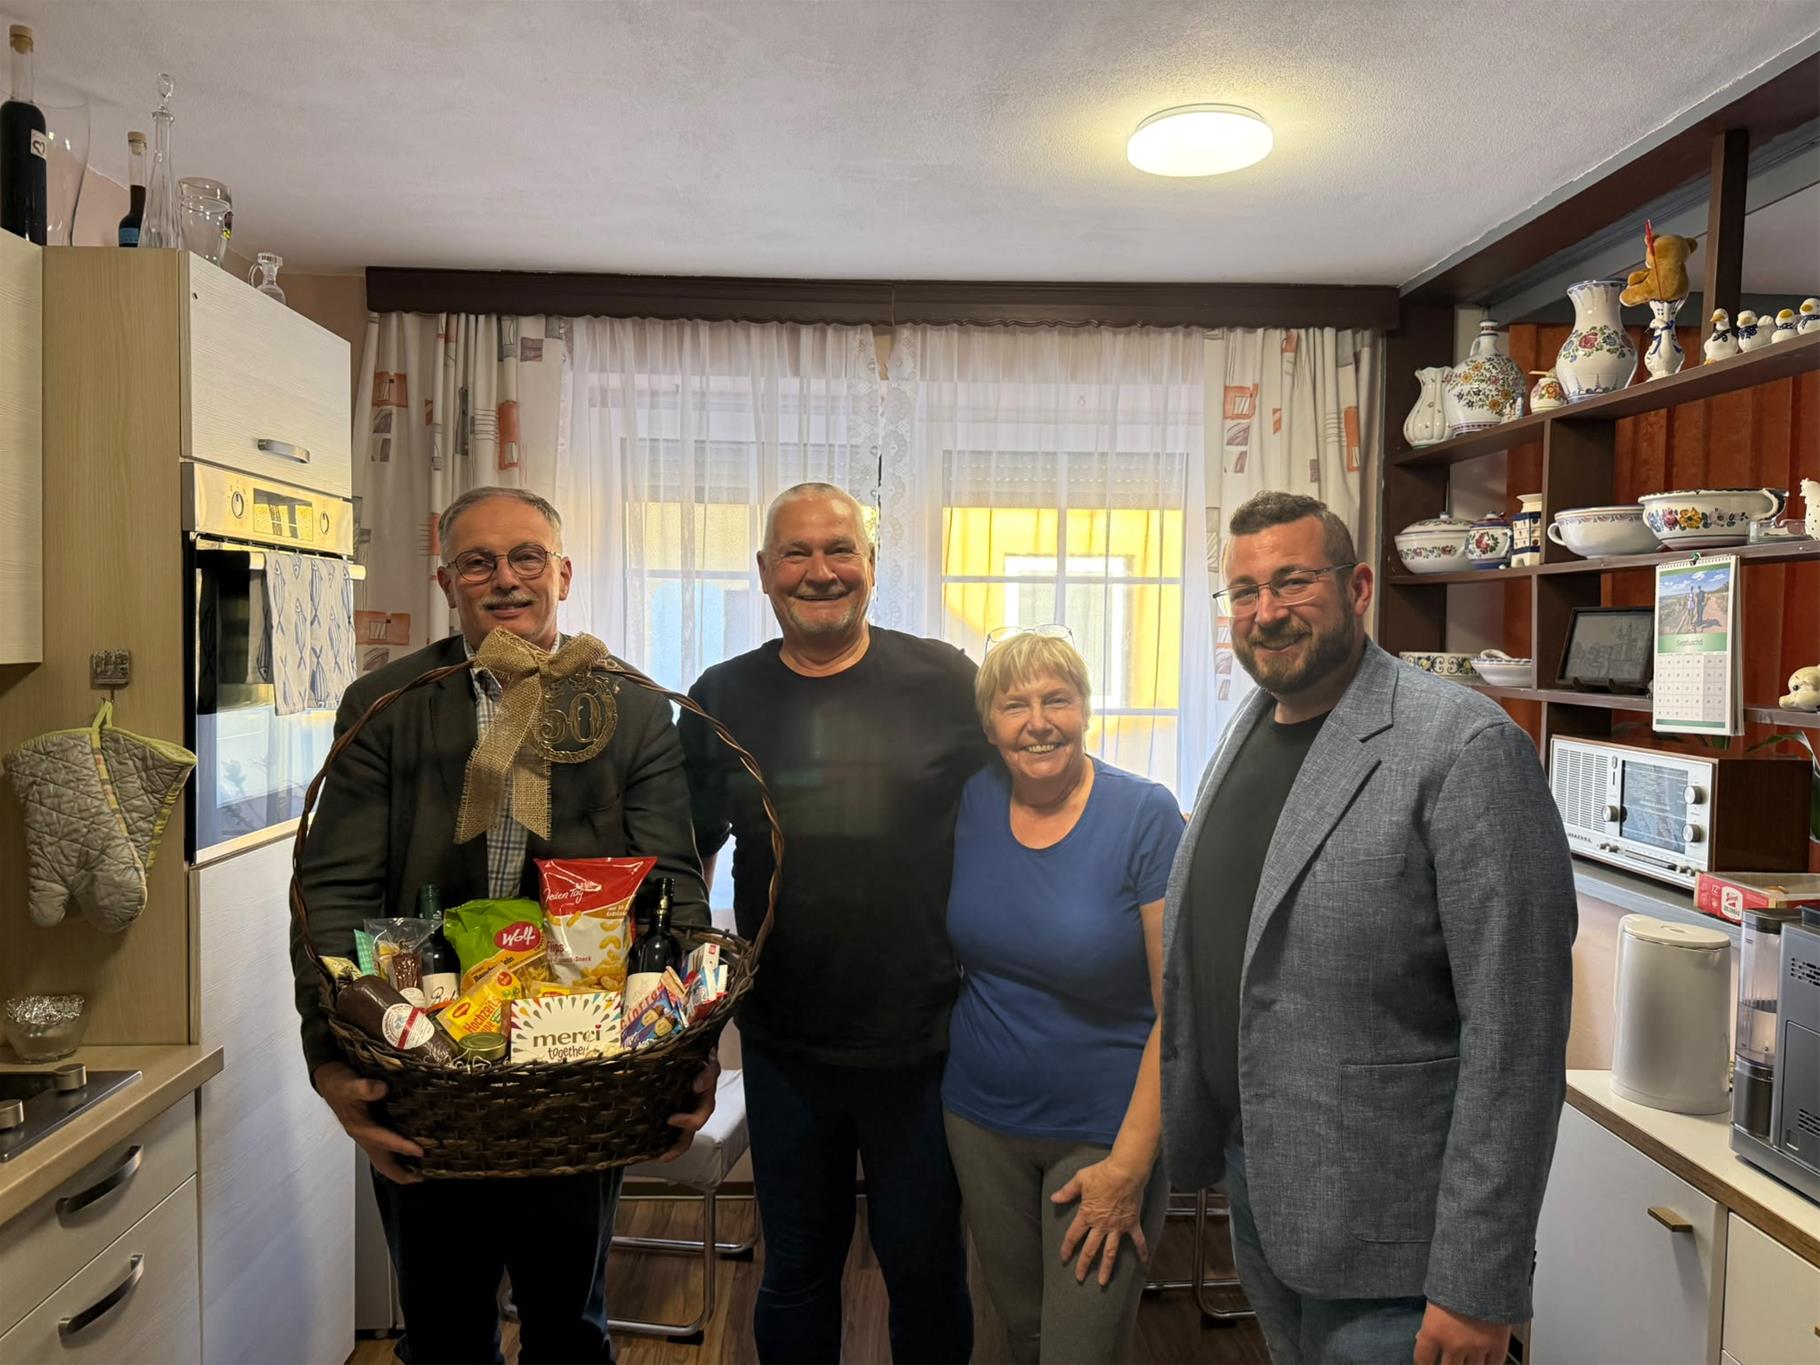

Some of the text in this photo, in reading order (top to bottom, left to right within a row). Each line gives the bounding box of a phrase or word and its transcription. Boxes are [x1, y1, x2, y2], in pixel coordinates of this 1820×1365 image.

[542, 692, 602, 744] 50
[543, 887, 584, 904] Jeden Tag
[502, 925, 535, 946] Wolf
[546, 940, 565, 954] Flips
[463, 995, 502, 1034] Hochzeits
[533, 1024, 600, 1047] merci
